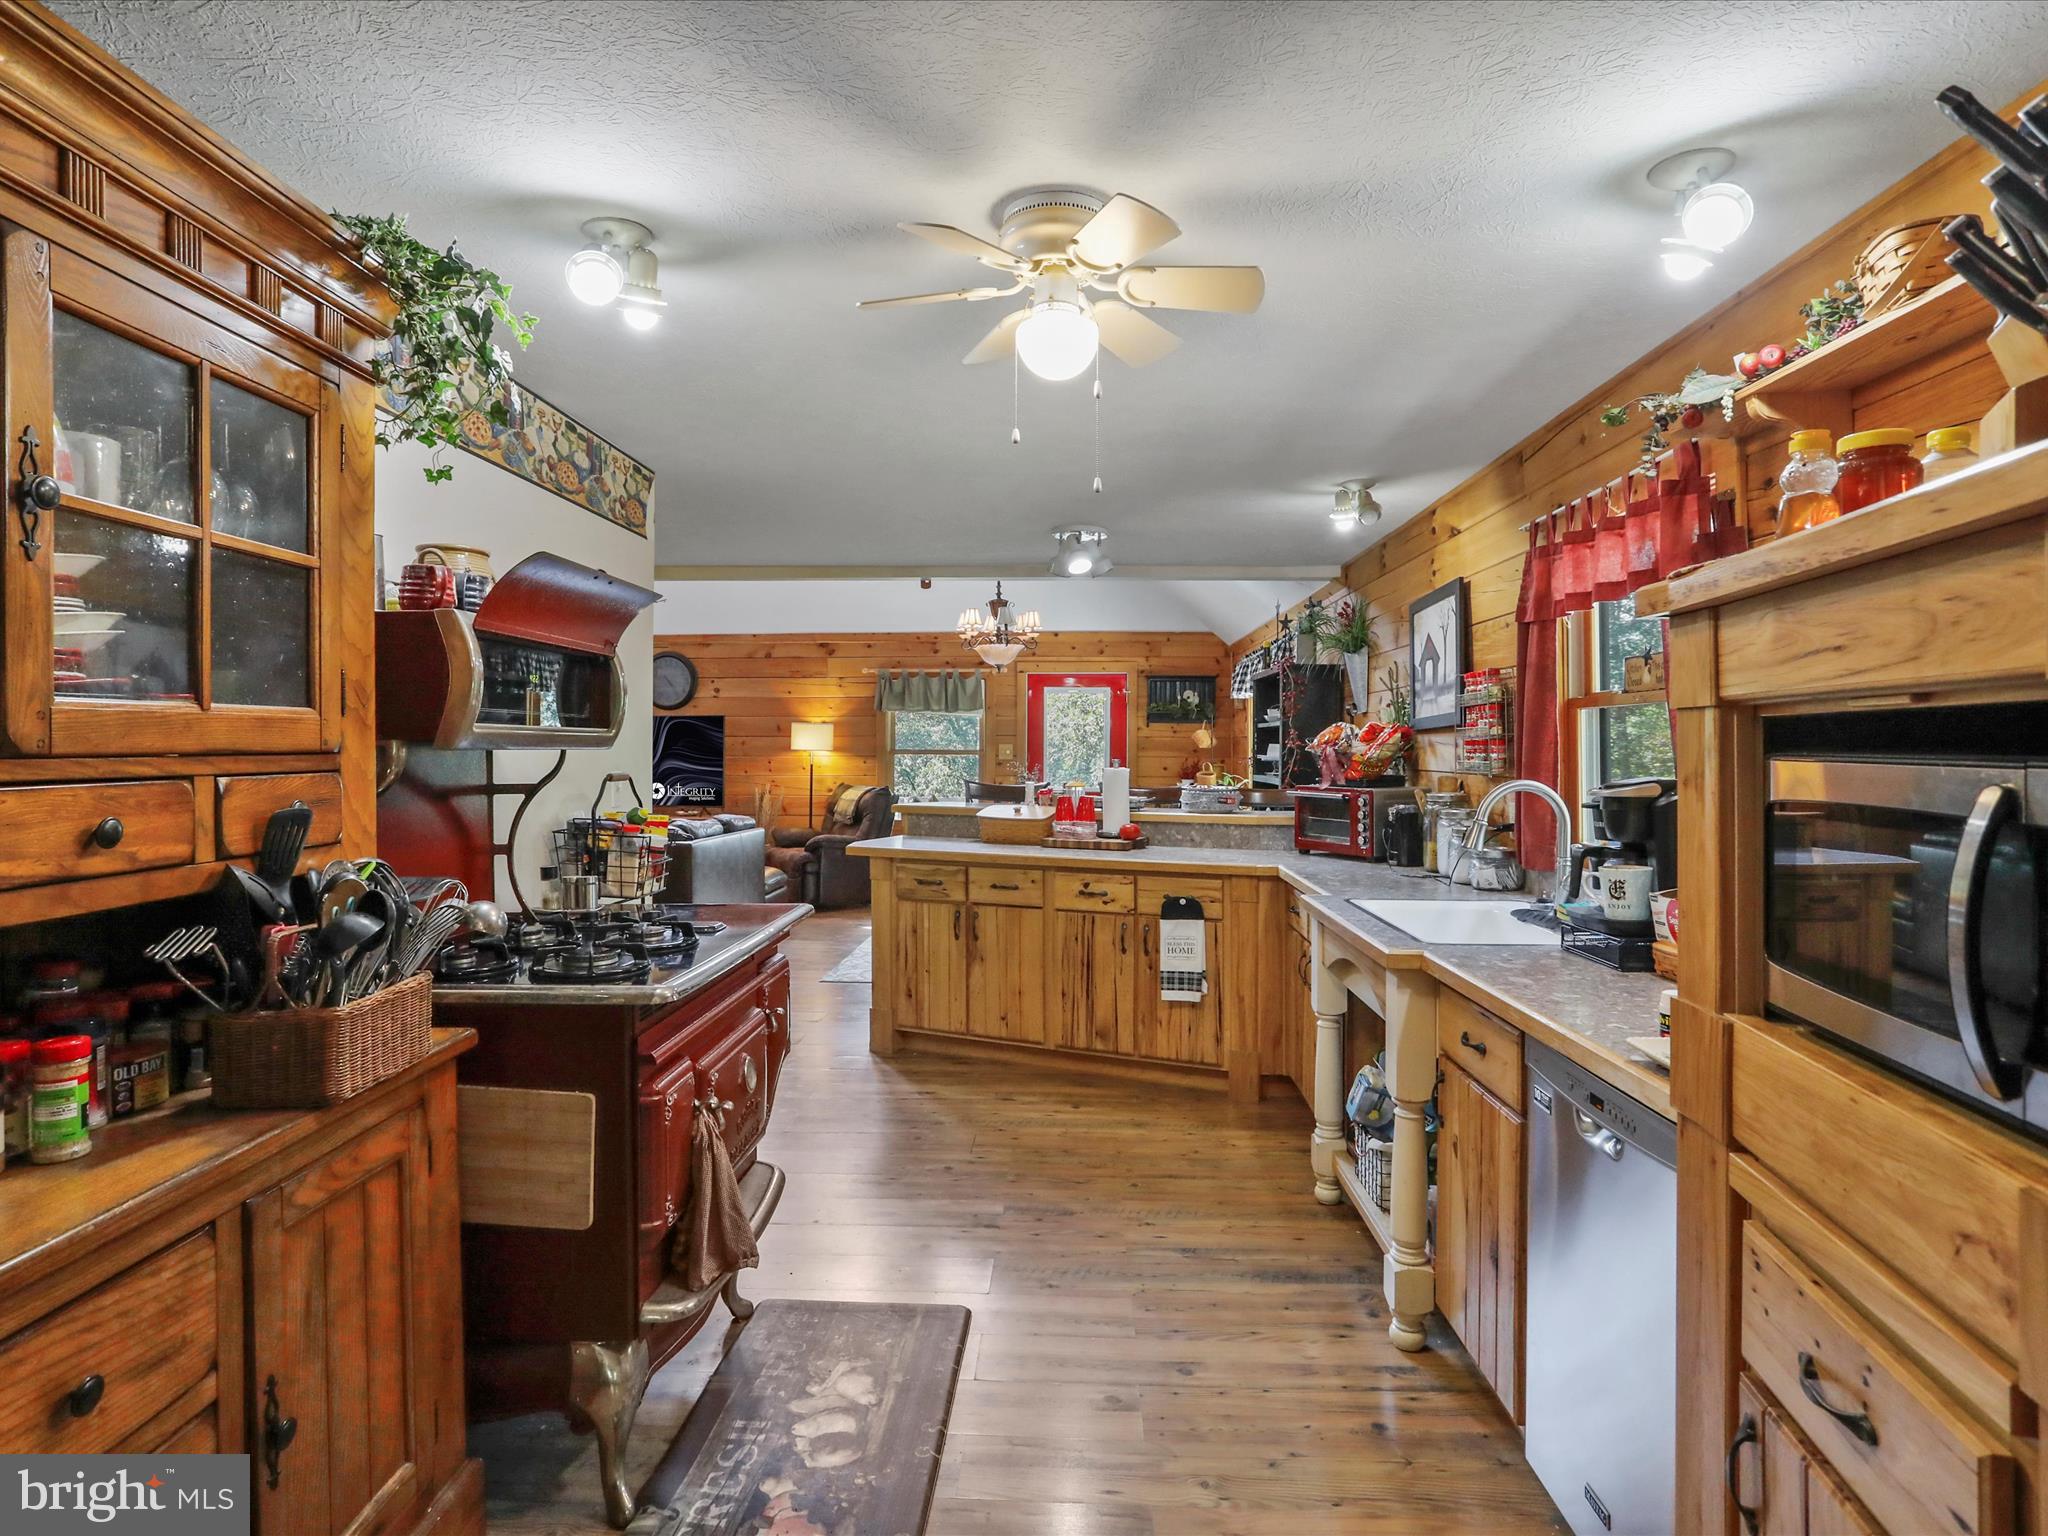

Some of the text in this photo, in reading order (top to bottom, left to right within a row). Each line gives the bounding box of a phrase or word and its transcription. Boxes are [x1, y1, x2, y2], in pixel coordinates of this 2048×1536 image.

[1167, 947, 1196, 955] HOME
[113, 1057, 162, 1081] OLD BAY
[676, 1419, 772, 1536] RESH
